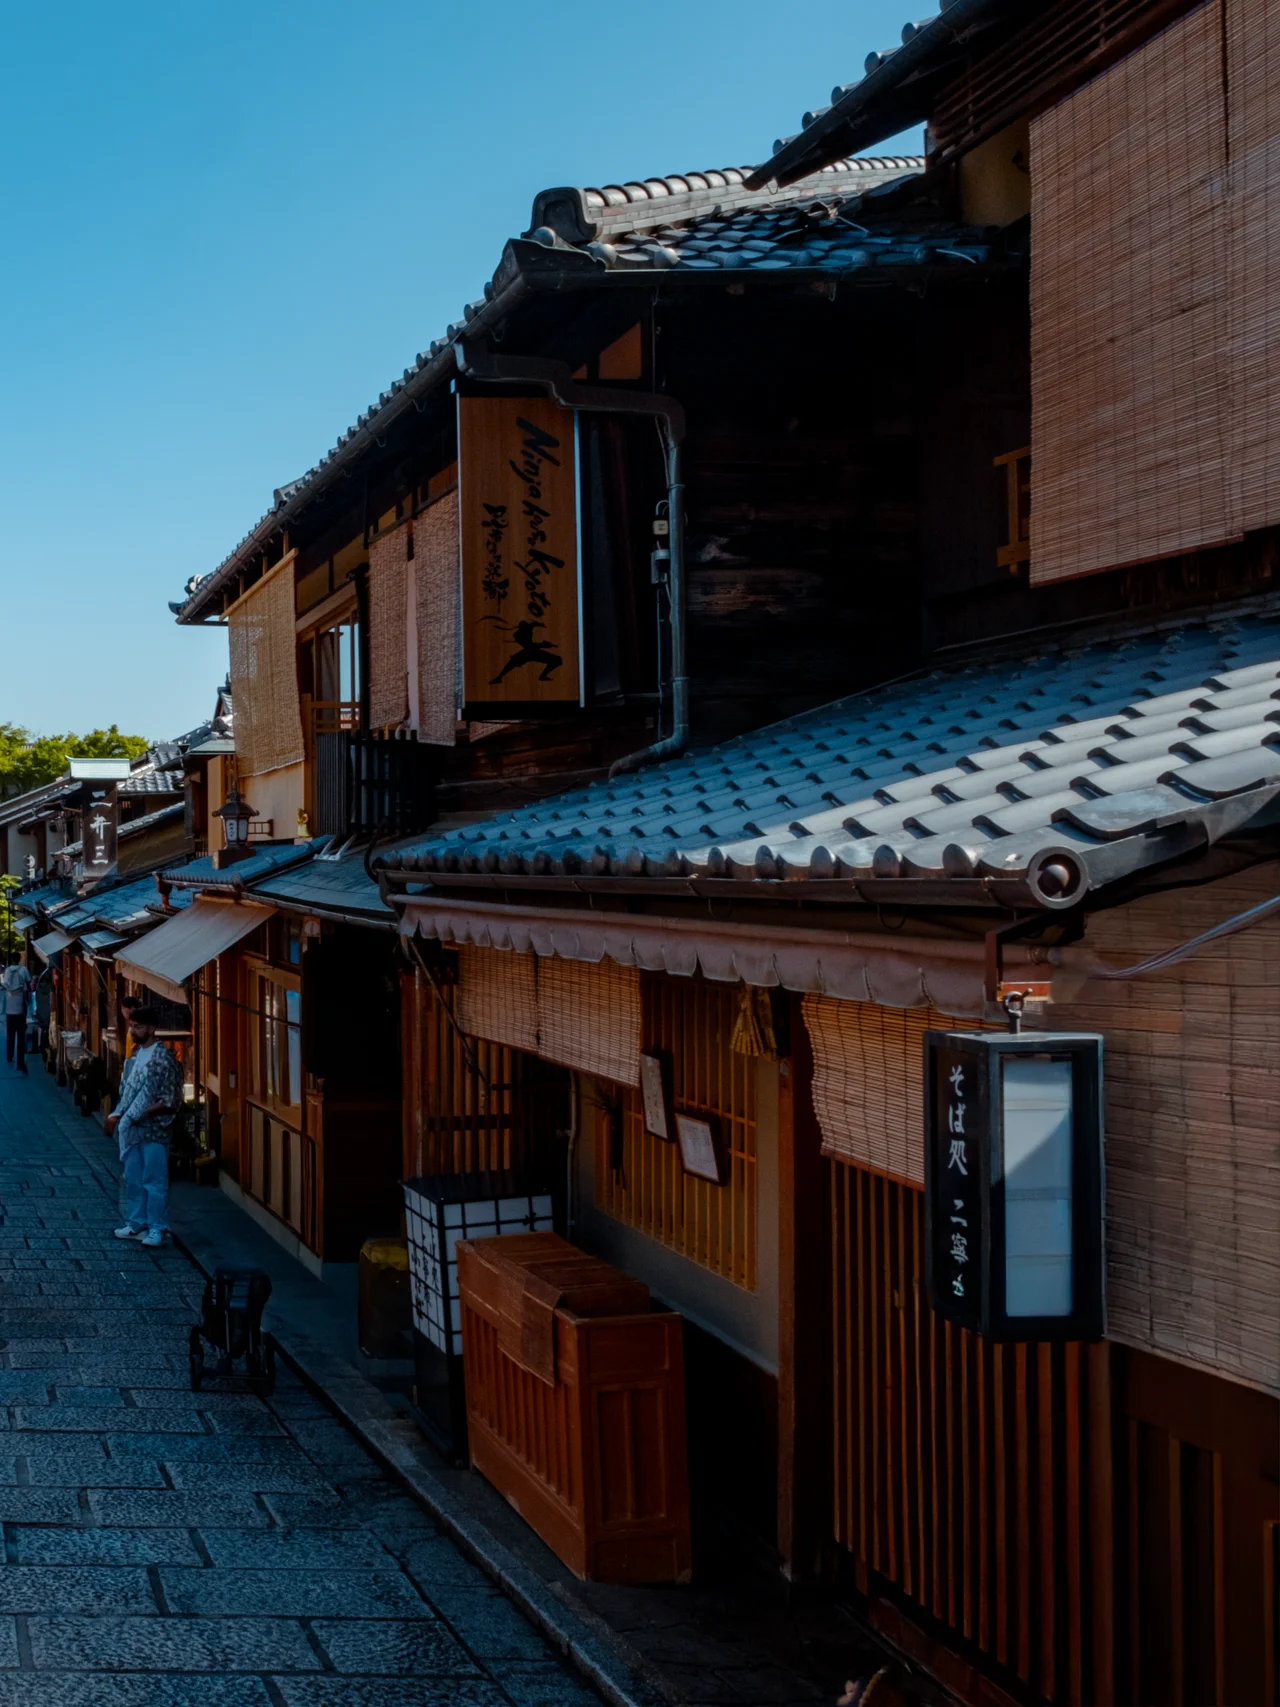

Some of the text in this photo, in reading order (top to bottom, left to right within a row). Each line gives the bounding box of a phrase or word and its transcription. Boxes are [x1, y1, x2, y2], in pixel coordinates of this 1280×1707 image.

[509, 417, 561, 499] Ninja
[513, 547, 565, 618] Kyoto
[89, 789, 113, 865] 二井三
[948, 1064, 968, 1176] そば処
